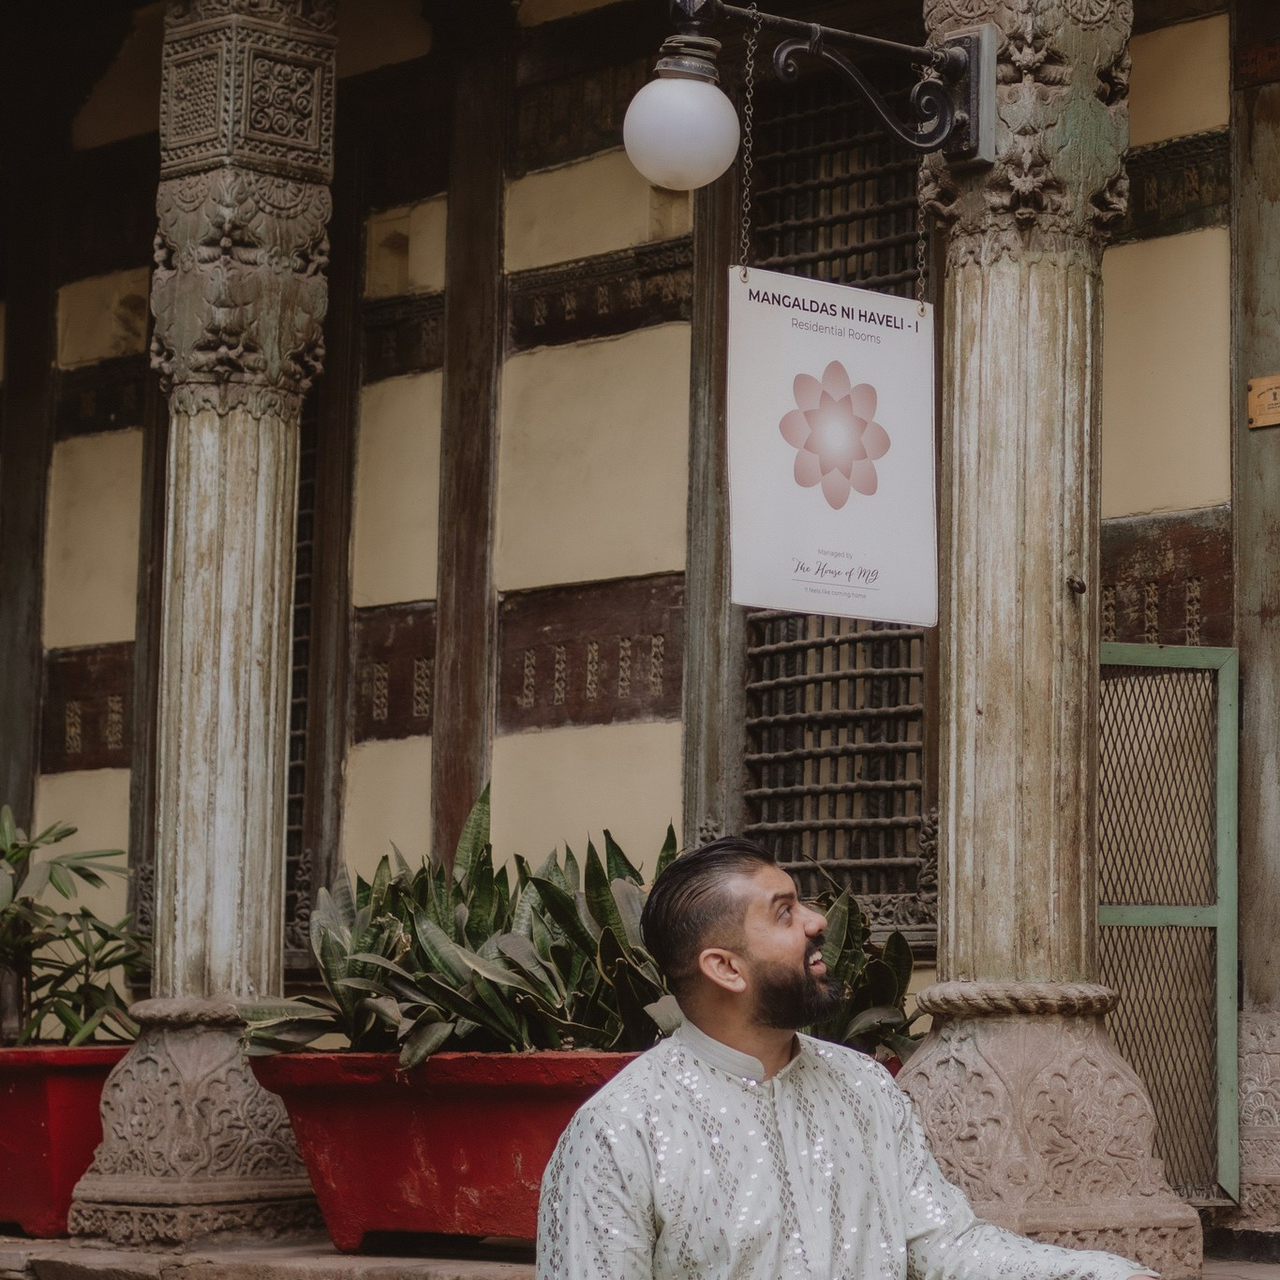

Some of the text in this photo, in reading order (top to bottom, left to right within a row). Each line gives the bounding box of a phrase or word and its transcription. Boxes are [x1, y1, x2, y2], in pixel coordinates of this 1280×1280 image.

[748, 288, 838, 317] MANGALDAS
[841, 305, 854, 321] NI
[858, 308, 904, 330] HAVELI
[791, 317, 882, 345] Residential Rooms
[817, 549, 845, 558] Managed
[792, 557, 879, 584] The House of MG
